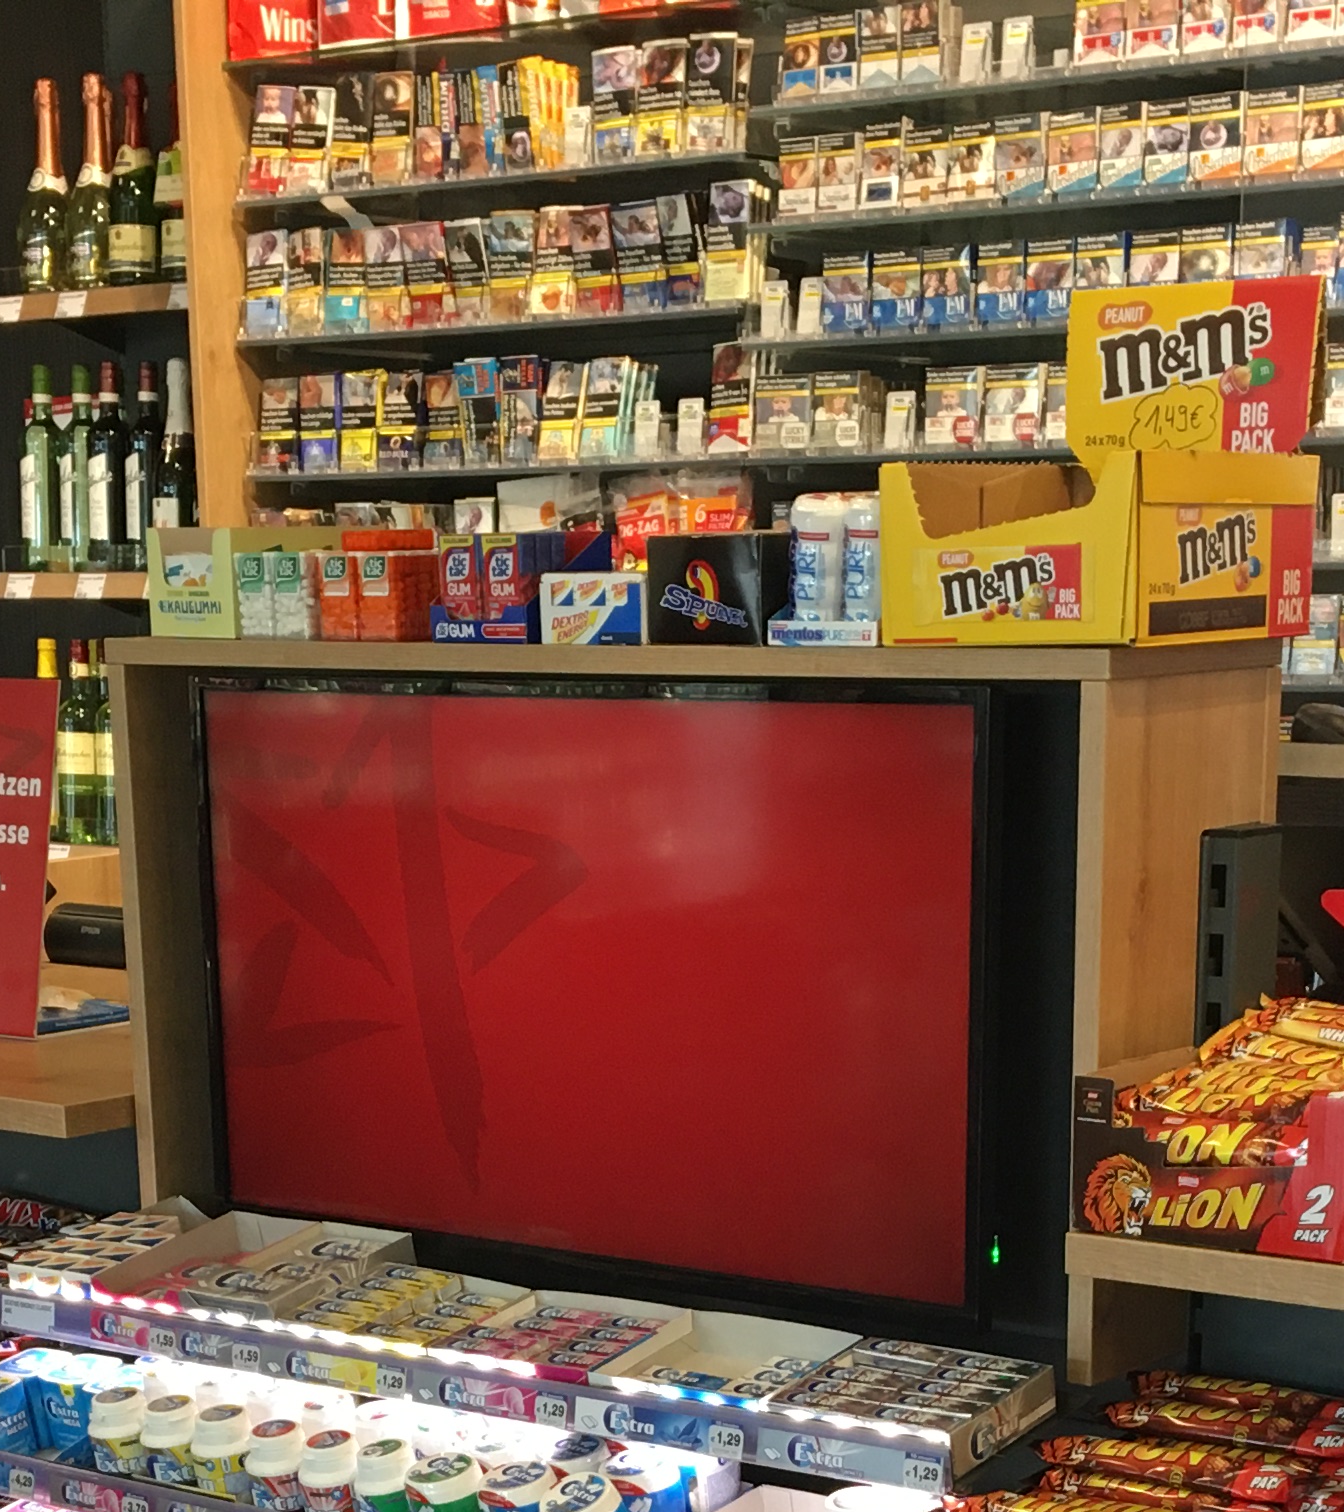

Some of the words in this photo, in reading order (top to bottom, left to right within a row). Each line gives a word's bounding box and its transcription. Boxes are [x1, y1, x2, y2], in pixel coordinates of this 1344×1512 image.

[1104, 304, 1148, 326] PEANUT
[1239, 401, 1269, 427] BIG
[1231, 429, 1275, 454] PACK
[940, 551, 970, 568] PEANUT
[447, 582, 471, 597] GUM
[491, 582, 515, 597] GUM
[449, 622, 475, 638] GUM
[551, 610, 590, 630] DEXTRO
[1299, 1184, 1335, 1225] 2
[1293, 1229, 1330, 1244] PACK
[609, 1407, 655, 1436] Extra
[793, 1441, 844, 1470] Extra
